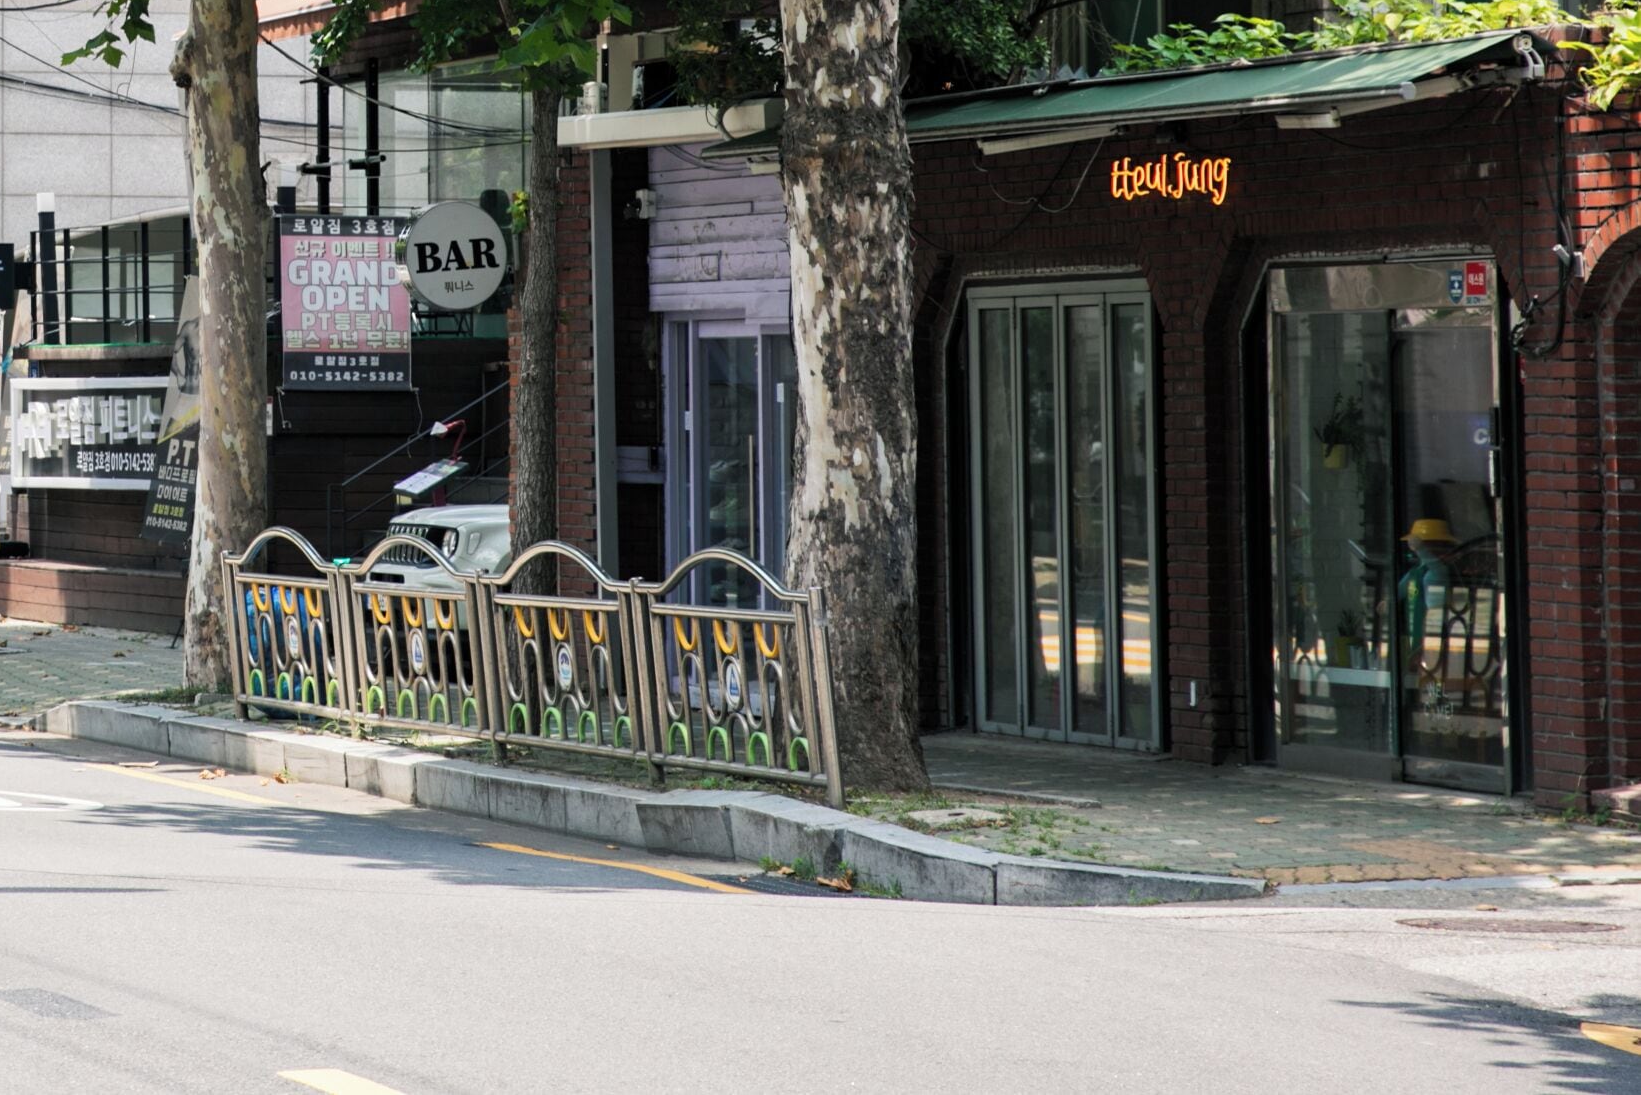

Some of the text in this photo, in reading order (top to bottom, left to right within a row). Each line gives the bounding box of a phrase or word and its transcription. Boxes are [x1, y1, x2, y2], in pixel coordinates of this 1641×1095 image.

[352, 219, 395, 236] 3호점
[294, 240, 327, 258] 신규
[331, 241, 380, 258] 이벤트
[414, 237, 500, 274] BAR
[288, 259, 402, 286] GRAND
[302, 286, 390, 312] OPEN
[285, 330, 408, 349] 헬스 1년 무료!
[289, 371, 405, 382] 010-5142-5382
[111, 452, 157, 473] 010-5142-538
[166, 438, 196, 467] P.T
[158, 465, 198, 485] 바디프로필
[156, 484, 189, 503] 다이어트
